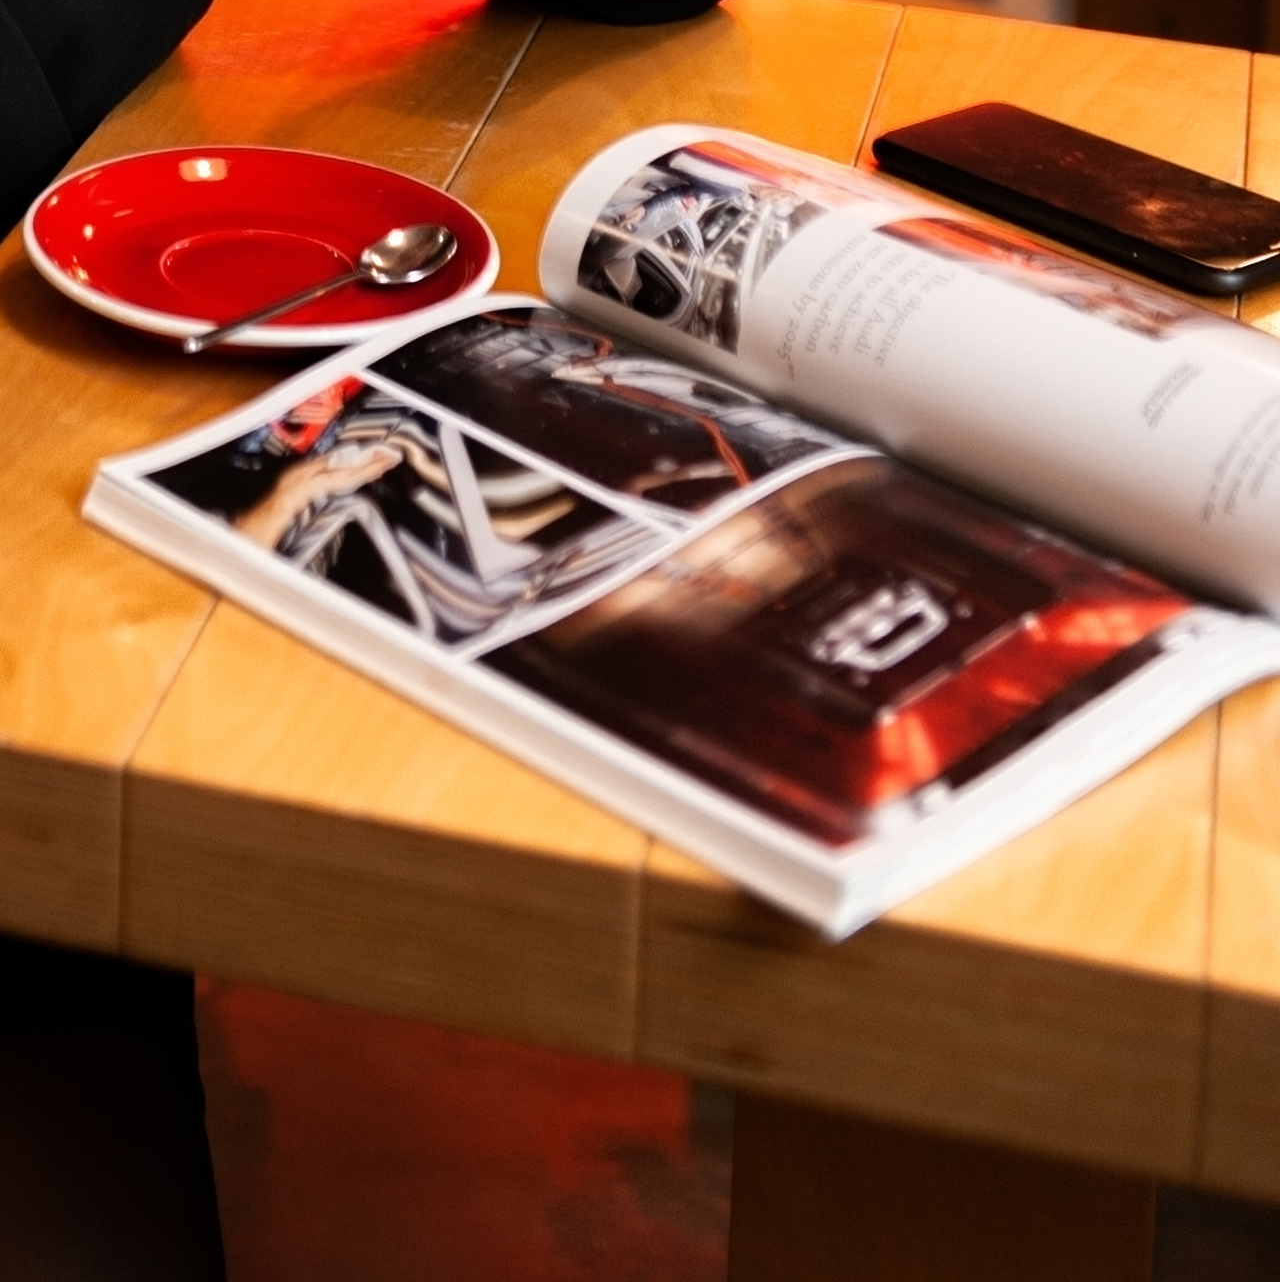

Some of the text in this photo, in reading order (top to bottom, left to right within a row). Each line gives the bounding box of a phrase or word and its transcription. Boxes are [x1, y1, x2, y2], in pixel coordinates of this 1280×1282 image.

[793, 293, 818, 316] by
[806, 293, 839, 354] carbon
[829, 291, 868, 355] achieve
[880, 287, 899, 310] all
[854, 308, 886, 357] Audi
[874, 294, 922, 368] objective
